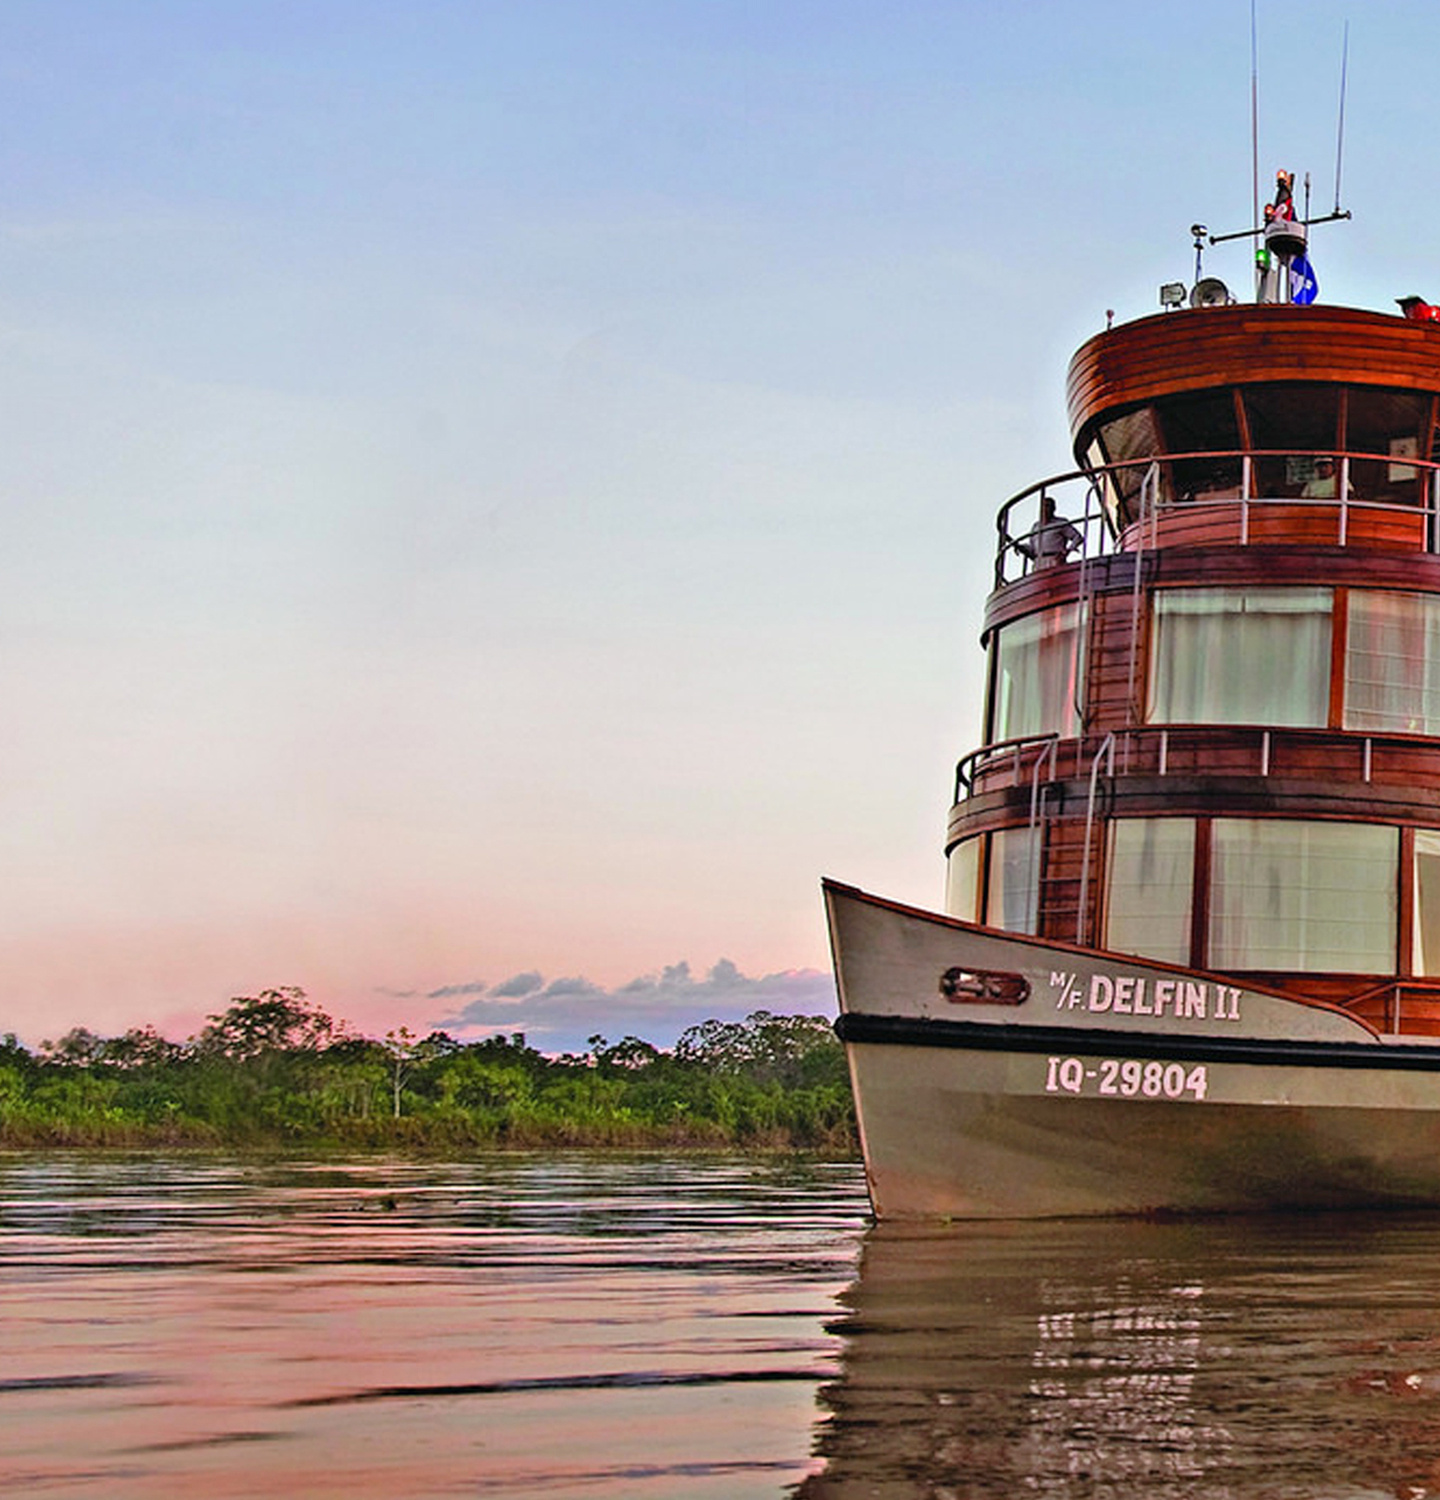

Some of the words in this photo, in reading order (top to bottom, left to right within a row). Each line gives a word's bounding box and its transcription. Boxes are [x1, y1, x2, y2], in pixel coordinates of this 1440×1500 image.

[1089, 975, 1207, 1018] DELFIN
[1214, 985, 1241, 1020] II
[1046, 1057, 1207, 1100] IQ-29804
